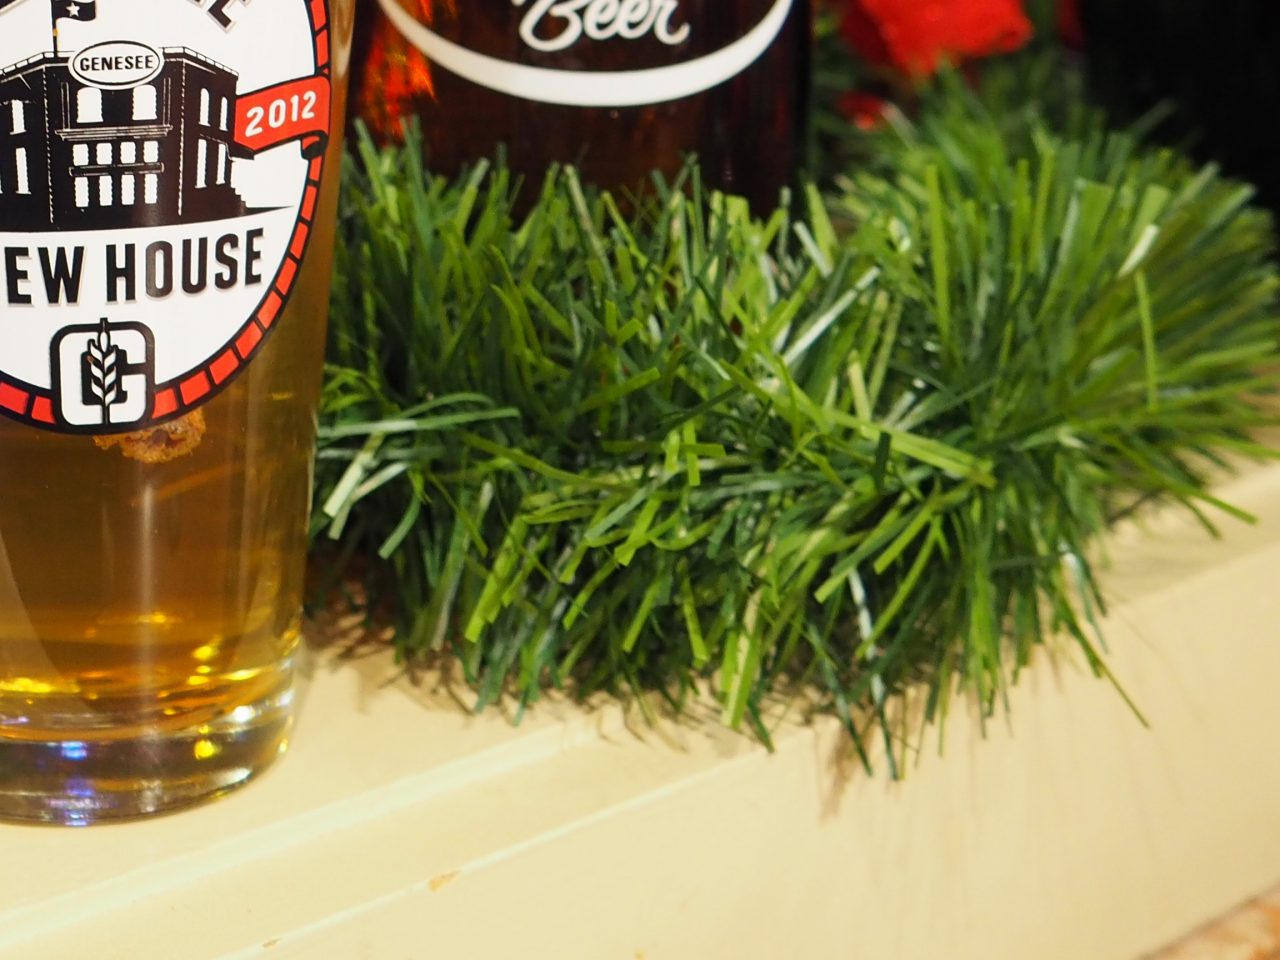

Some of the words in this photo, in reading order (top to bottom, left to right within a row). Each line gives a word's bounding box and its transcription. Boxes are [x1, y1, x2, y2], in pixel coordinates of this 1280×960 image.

[78, 52, 155, 72] GENESEE
[244, 92, 315, 138] 2012
[105, 226, 265, 303] HOUSE
